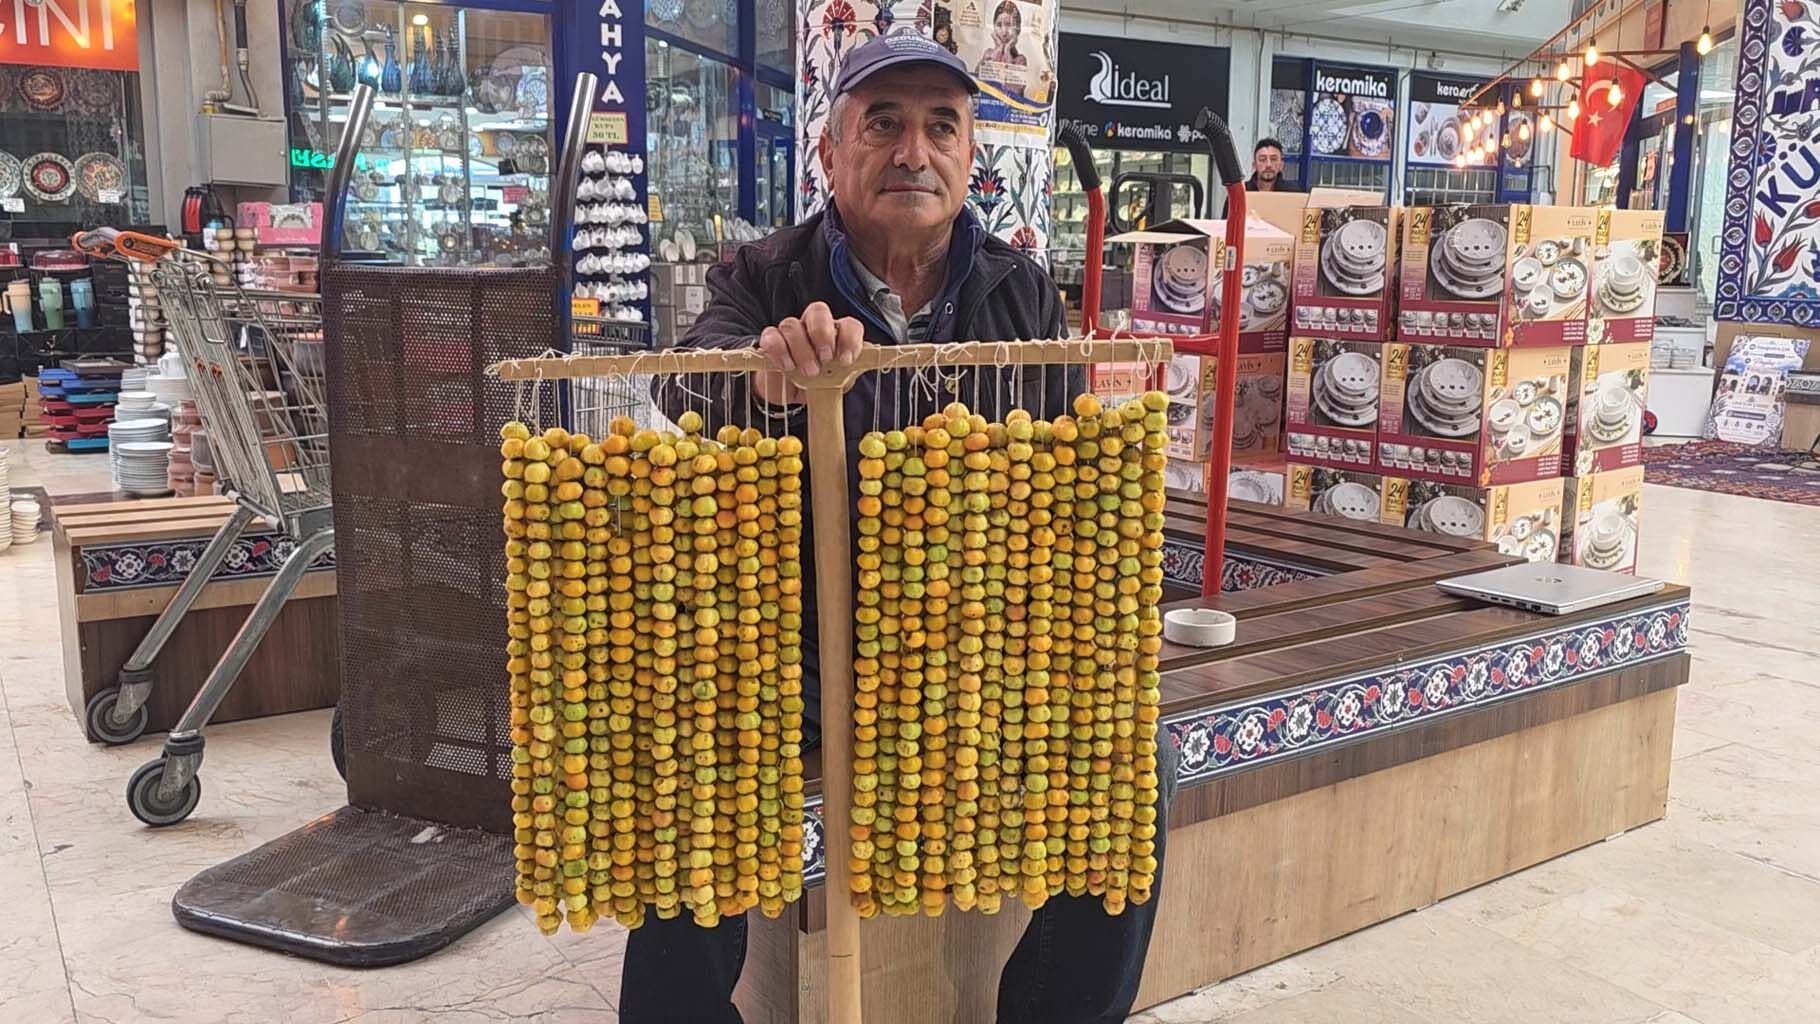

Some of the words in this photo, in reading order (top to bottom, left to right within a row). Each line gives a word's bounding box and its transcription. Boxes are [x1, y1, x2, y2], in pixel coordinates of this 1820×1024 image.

[1114, 64, 1169, 101] ideal
[1316, 70, 1387, 97] keramika
[1117, 123, 1173, 140] keramika
[1388, 349, 1406, 365] 24
[1387, 482, 1406, 499] 24
